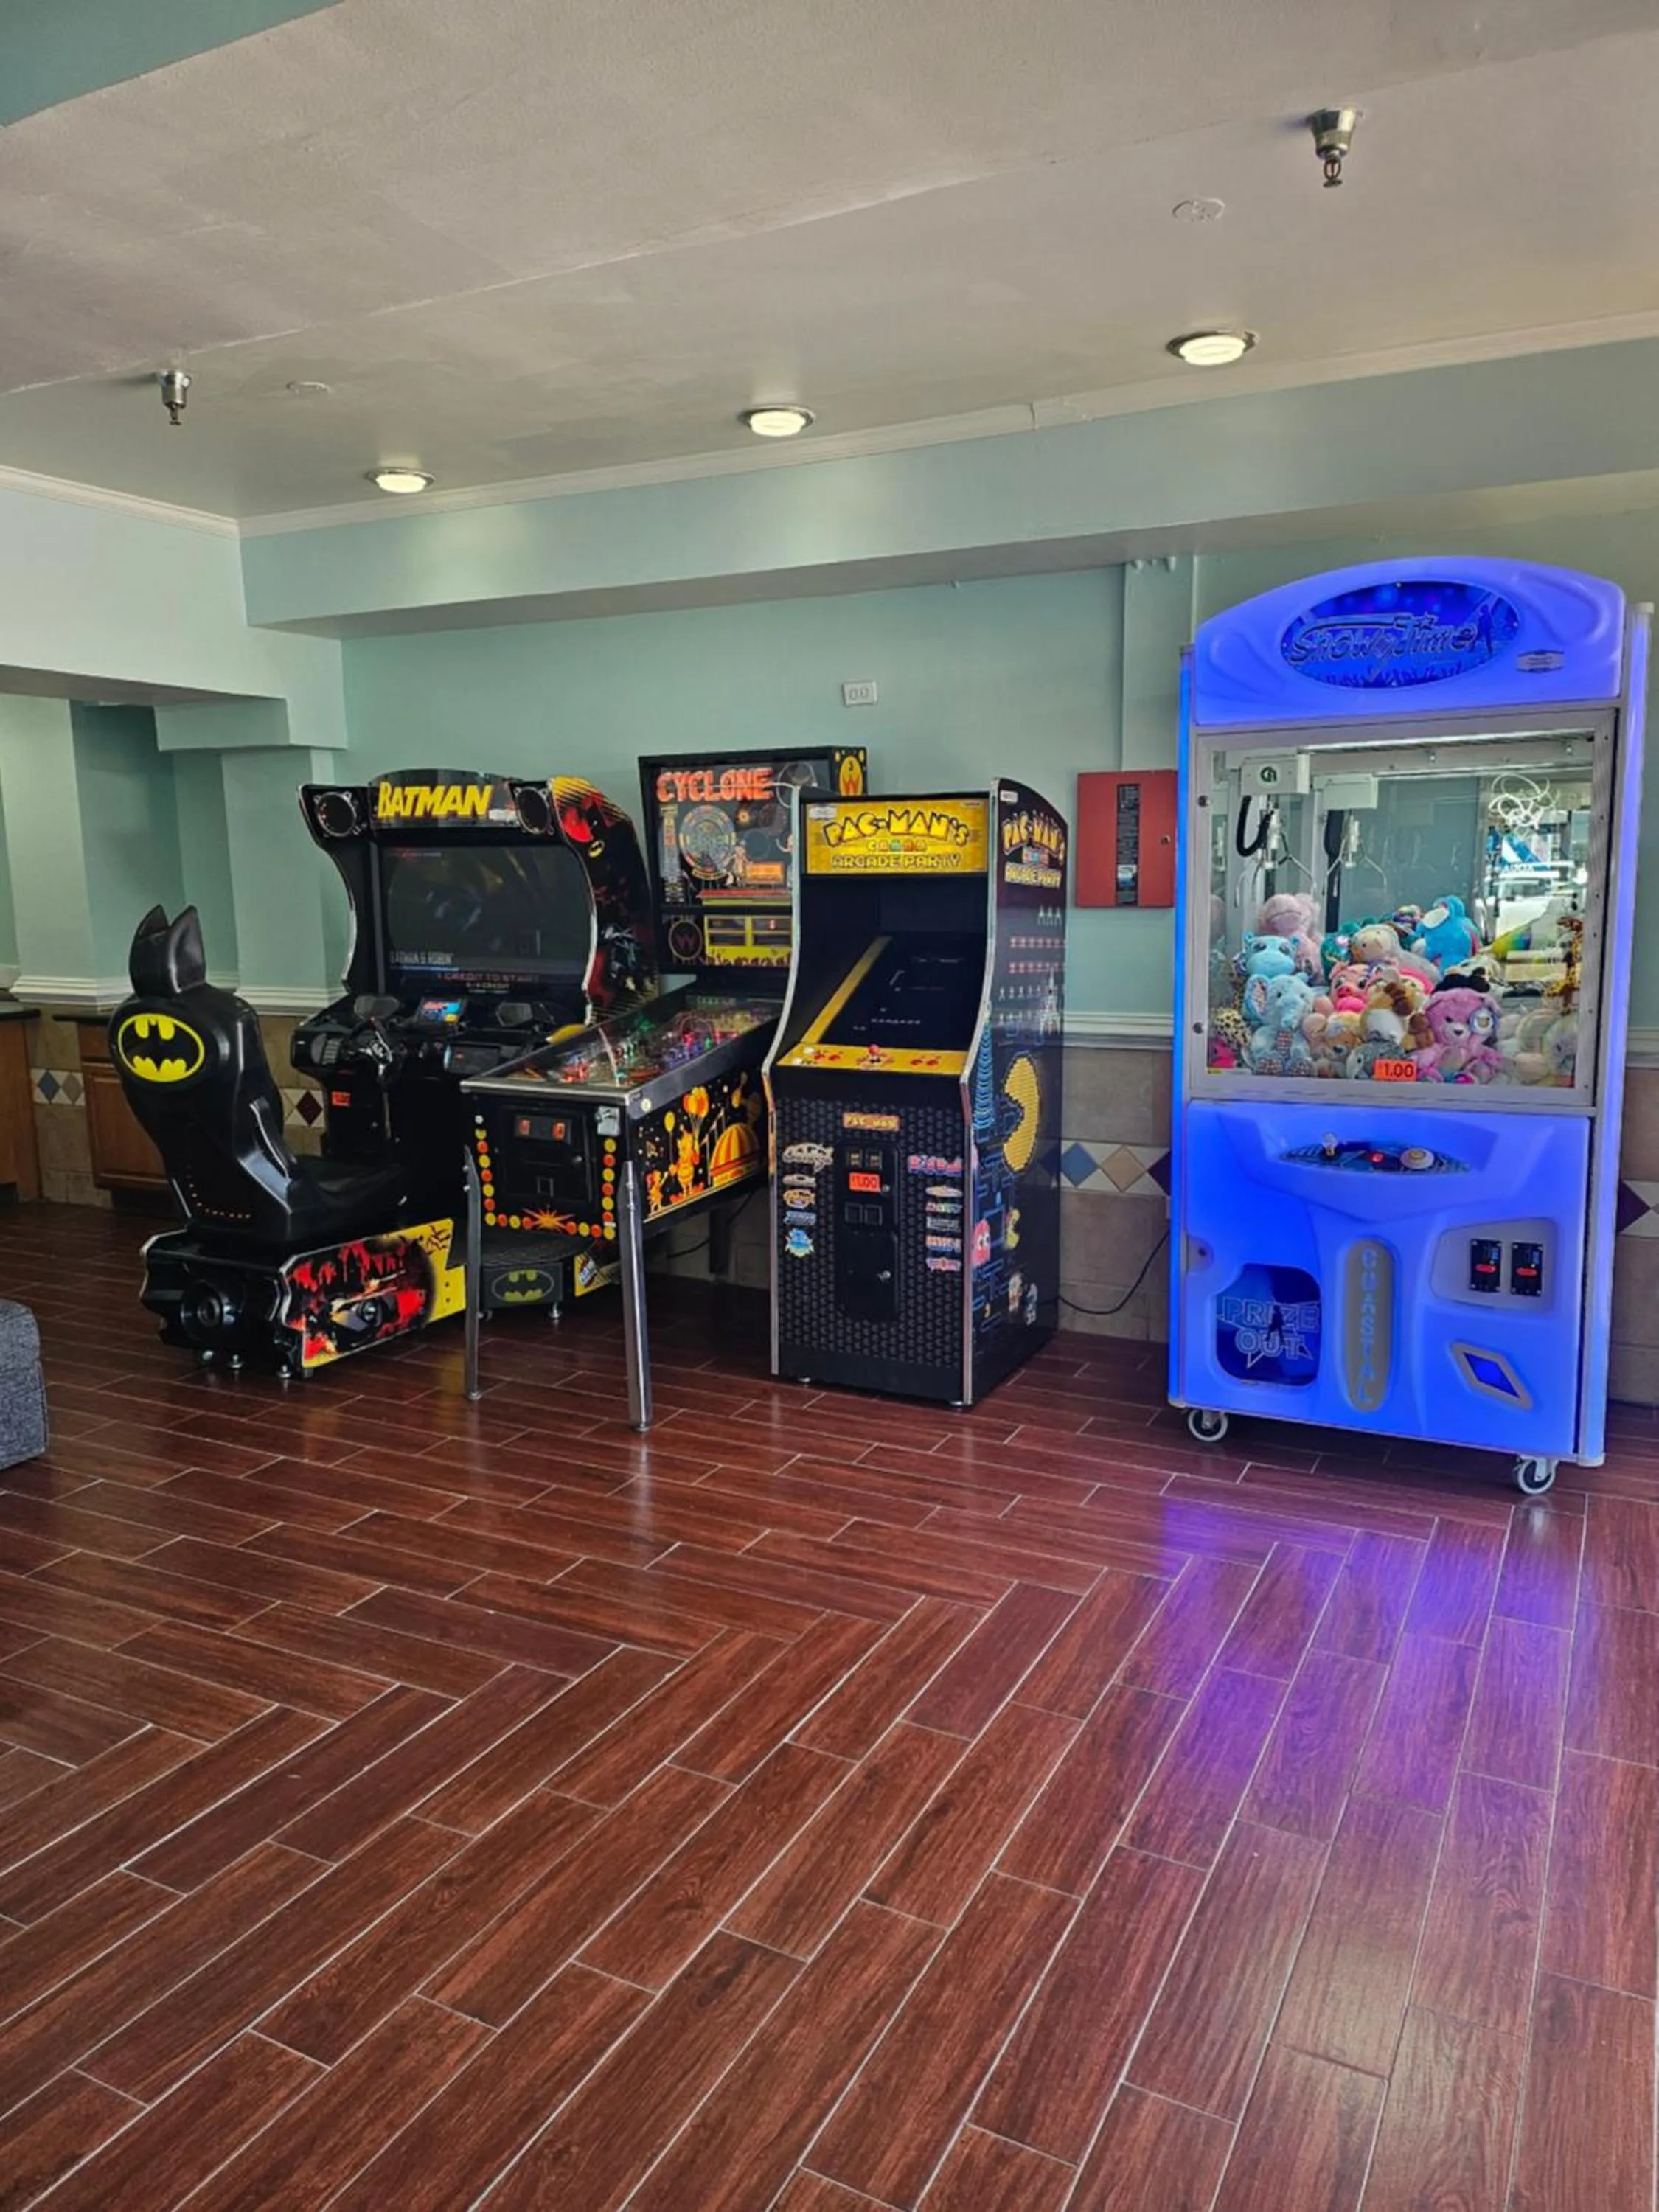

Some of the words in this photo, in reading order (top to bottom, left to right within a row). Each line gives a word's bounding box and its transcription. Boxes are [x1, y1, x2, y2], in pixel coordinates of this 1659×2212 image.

[377, 782, 493, 819] BATMAN
[656, 767, 774, 802] CYCLONE
[822, 808, 970, 848] PAC-MAN'S
[832, 853, 901, 869] ARCADE
[903, 852, 961, 869] PARTY
[1222, 1297, 1320, 1333] PRIZE
[1234, 1329, 1305, 1360] OUT
